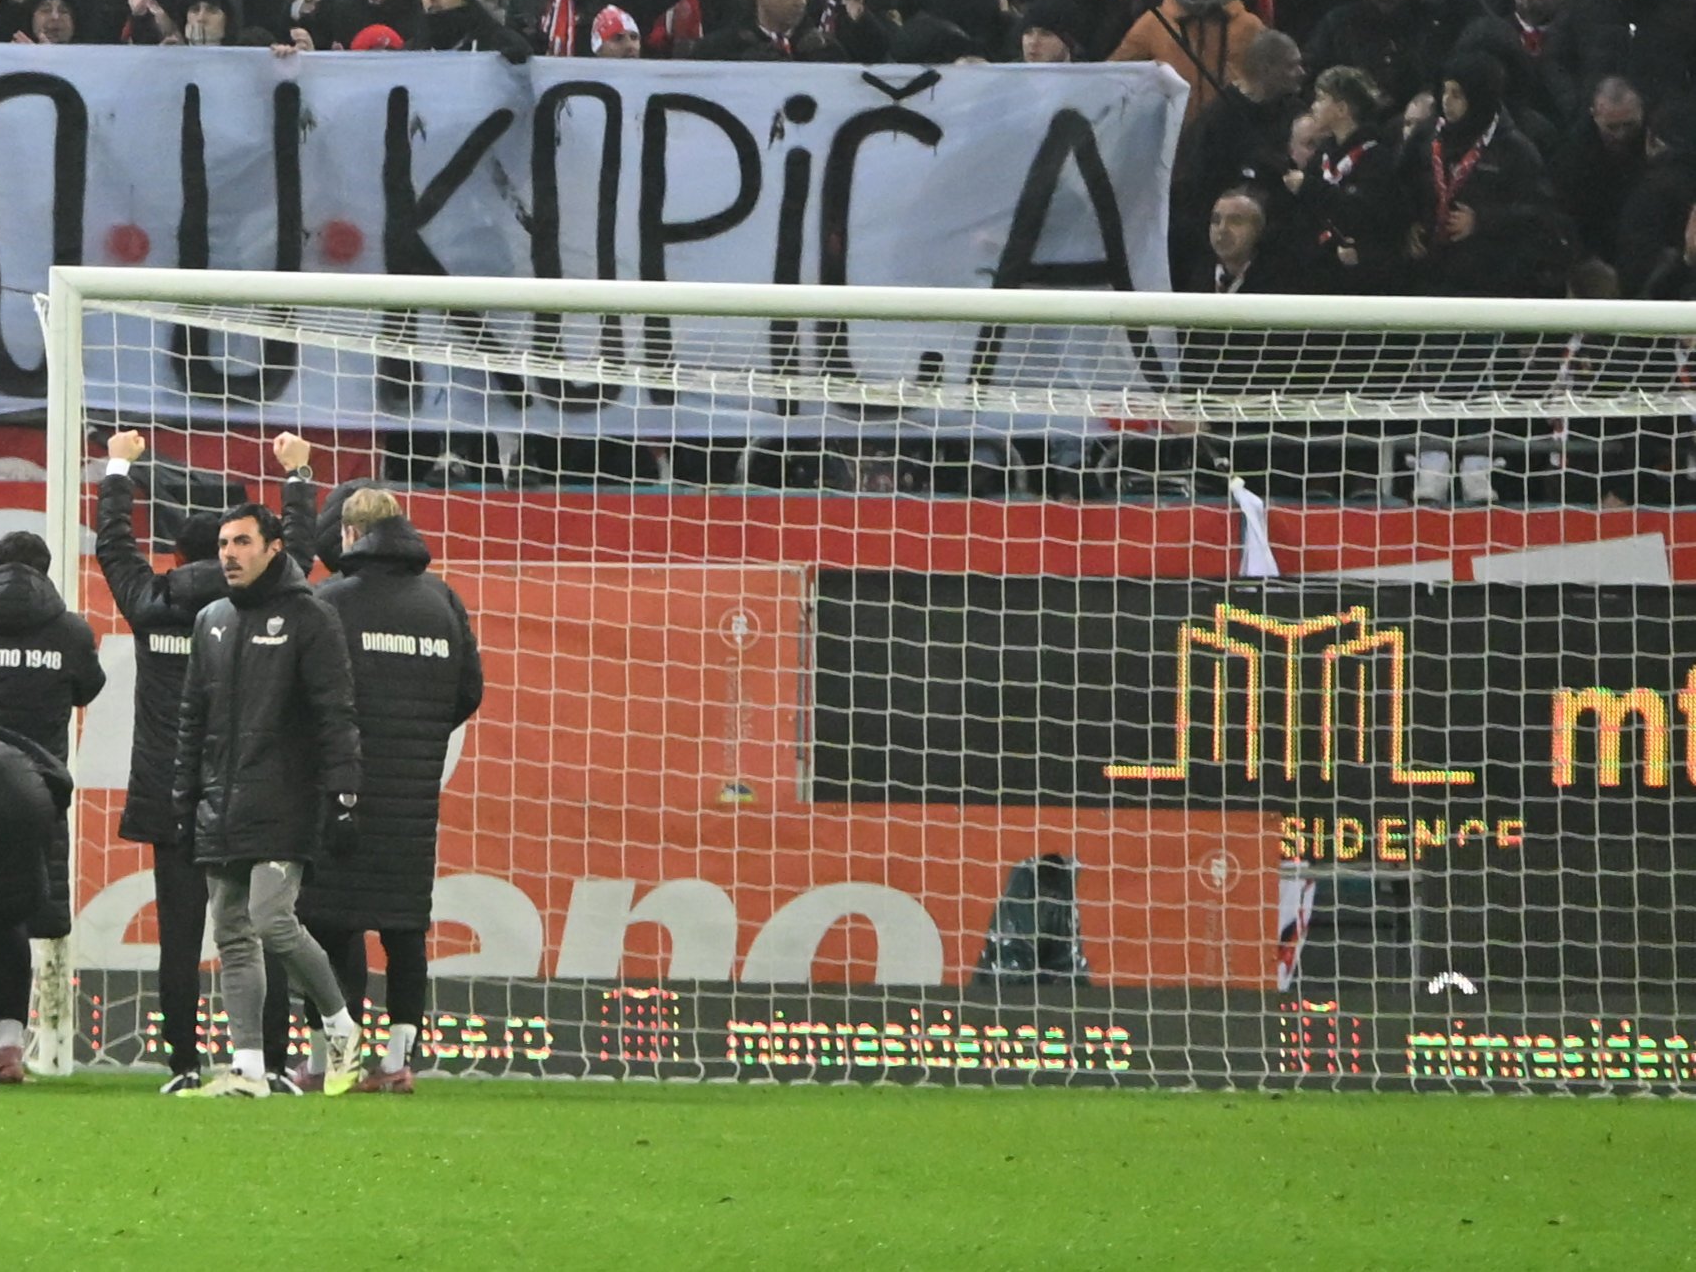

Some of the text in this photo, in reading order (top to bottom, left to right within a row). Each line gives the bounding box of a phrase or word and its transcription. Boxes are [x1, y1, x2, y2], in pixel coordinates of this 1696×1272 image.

[172, 79, 302, 403] U
[149, 633, 191, 655] DINA
[361, 632, 450, 658] DINAMO 1948
[25, 649, 62, 670] 1948
